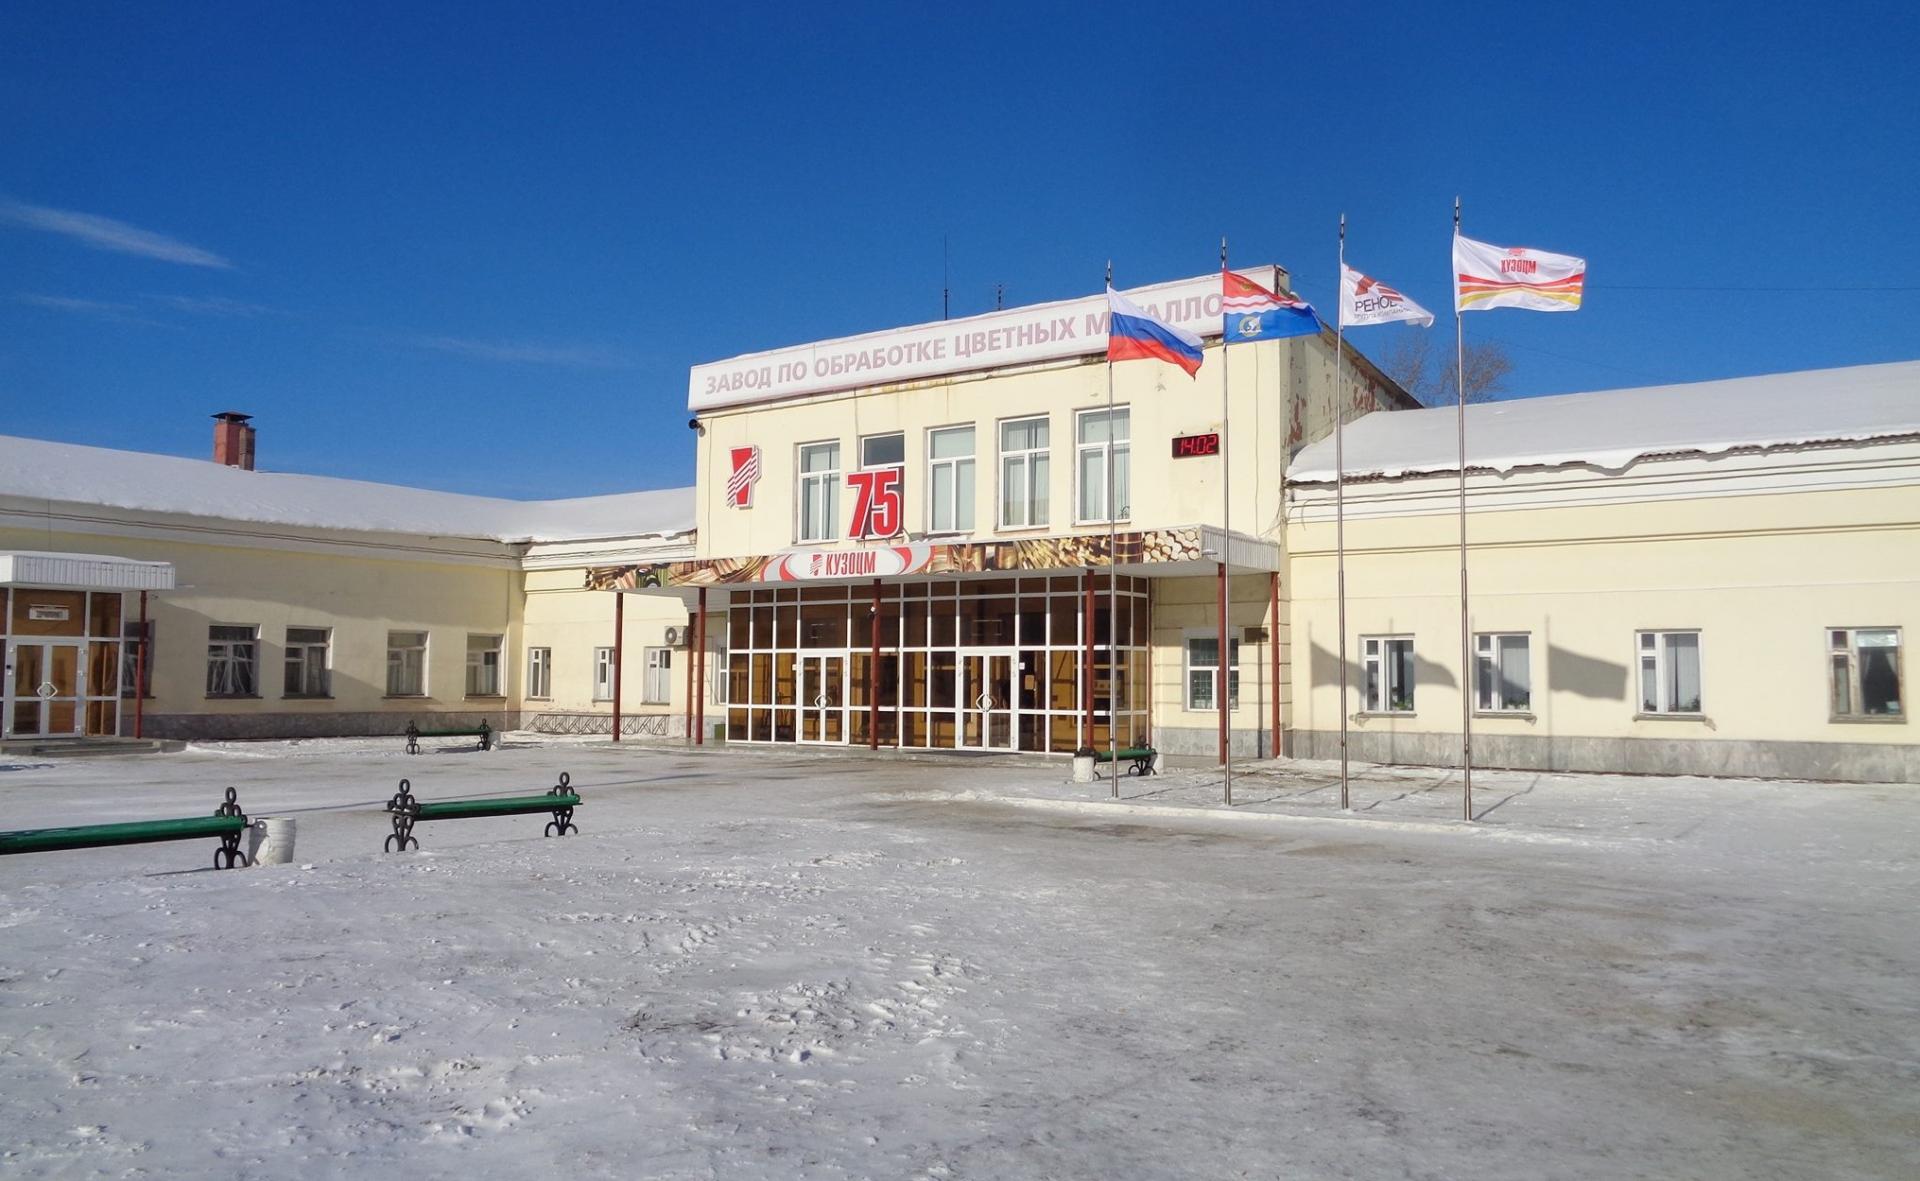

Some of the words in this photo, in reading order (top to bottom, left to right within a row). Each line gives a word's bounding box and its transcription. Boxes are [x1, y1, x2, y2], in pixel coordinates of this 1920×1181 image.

[1501, 259, 1537, 275] КУЗОЦМ
[1355, 296, 1398, 312] РЕНО
[705, 366, 772, 395] ЗАВОД
[777, 360, 808, 384] ПО
[814, 337, 947, 377] ОБРАБОТКЕ
[954, 316, 1076, 359] ЦВЕТНЫХ
[1085, 292, 1224, 337] МАЛЛО
[846, 468, 900, 539] 75
[825, 551, 877, 576] КУЗОЦМ
